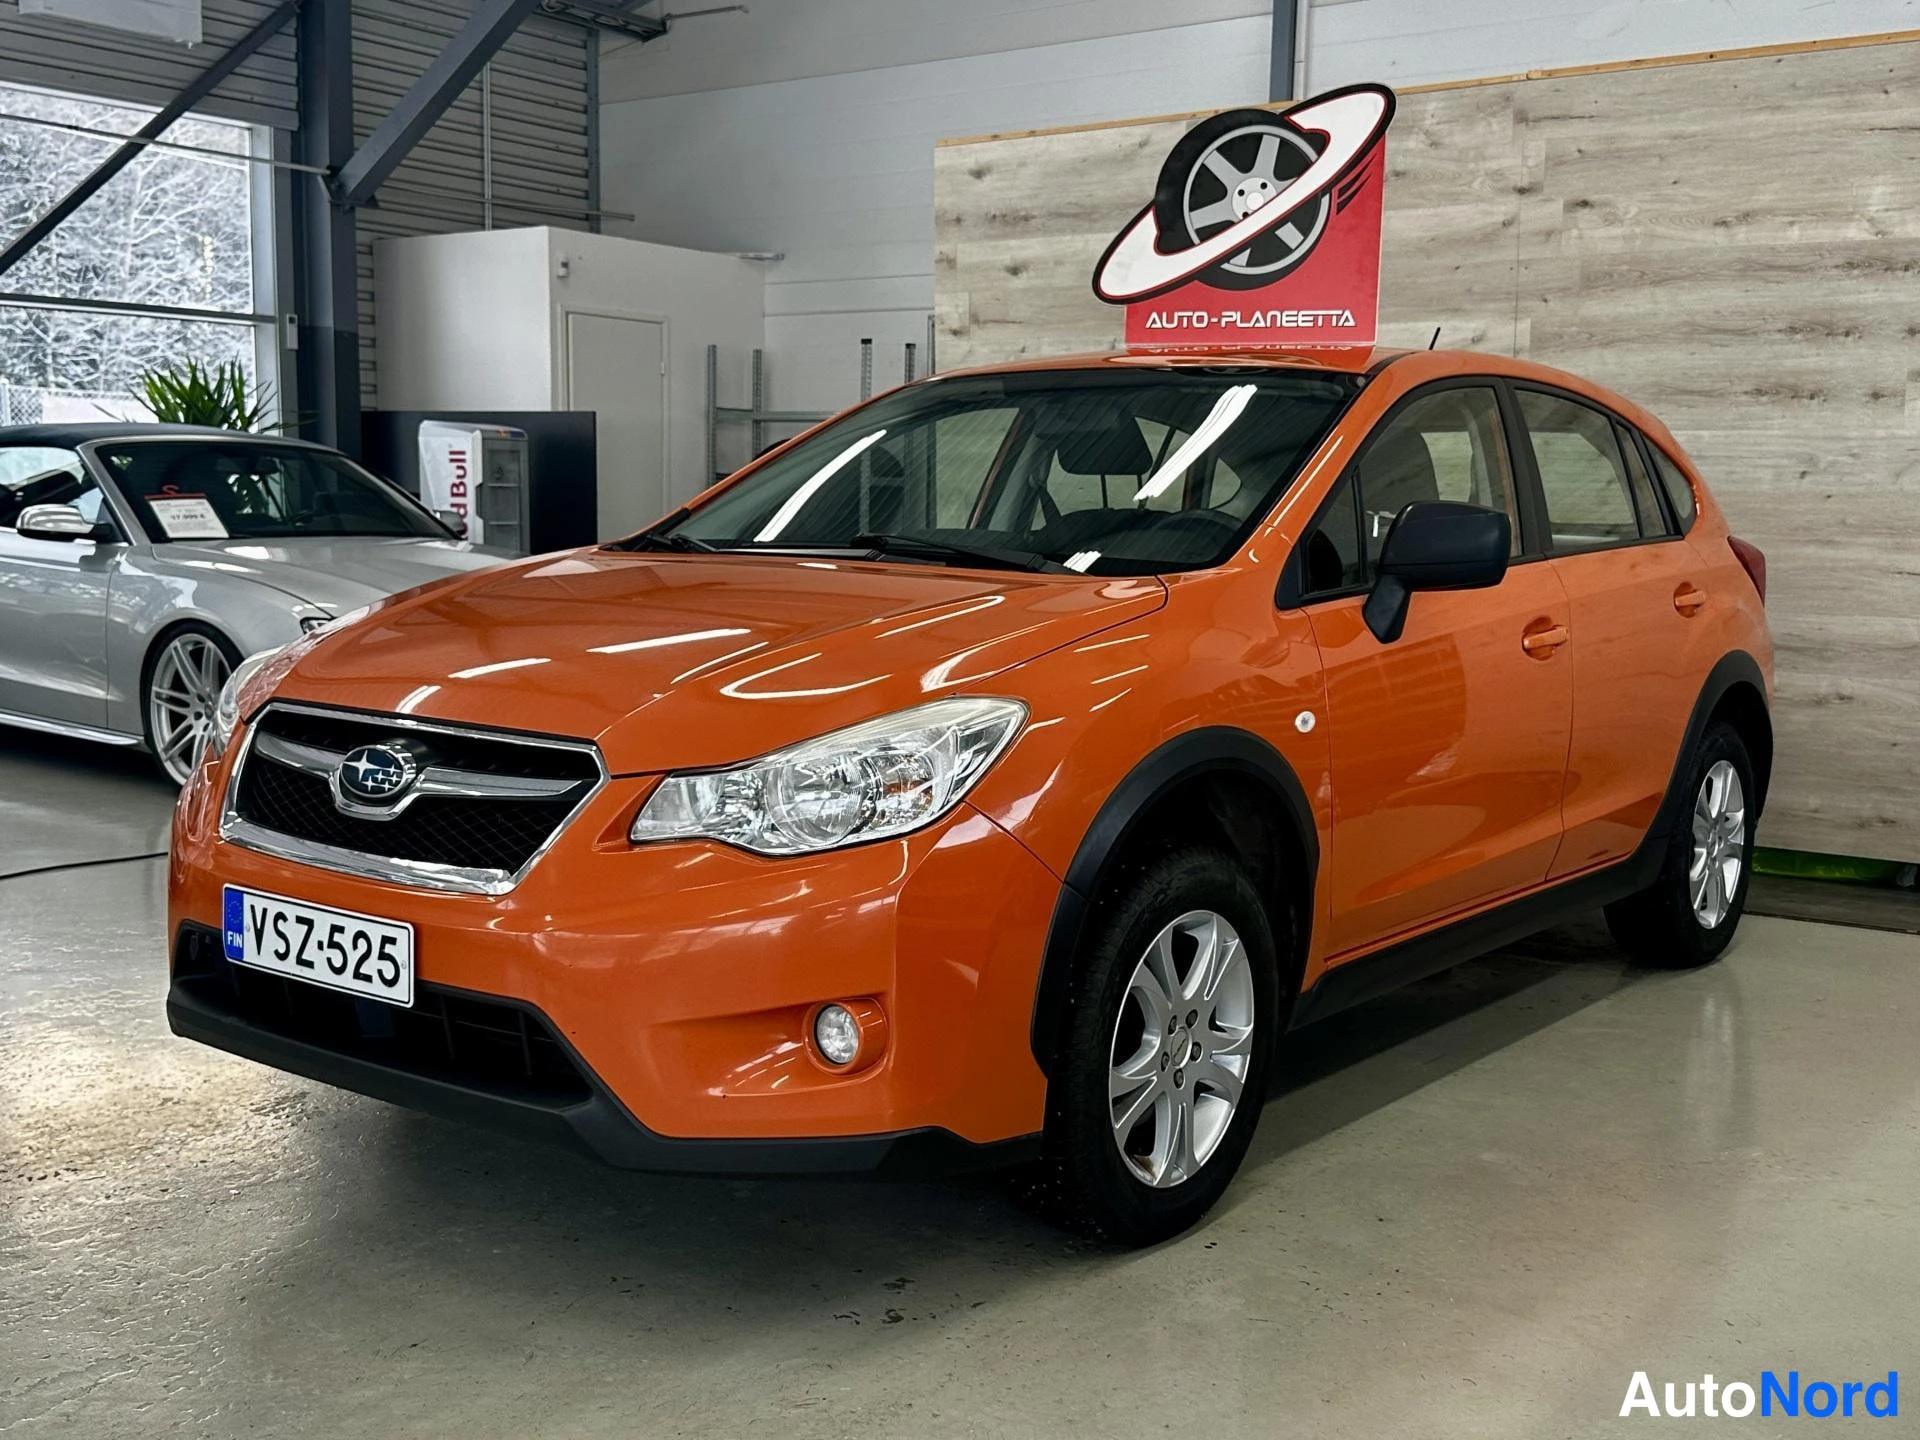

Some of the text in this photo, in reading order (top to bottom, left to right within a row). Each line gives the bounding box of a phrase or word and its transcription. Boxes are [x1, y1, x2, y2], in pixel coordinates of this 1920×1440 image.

[1145, 309, 1356, 328] AUTO-PLANEETTA
[448, 450, 468, 497] Bull
[227, 931, 243, 948] FIN
